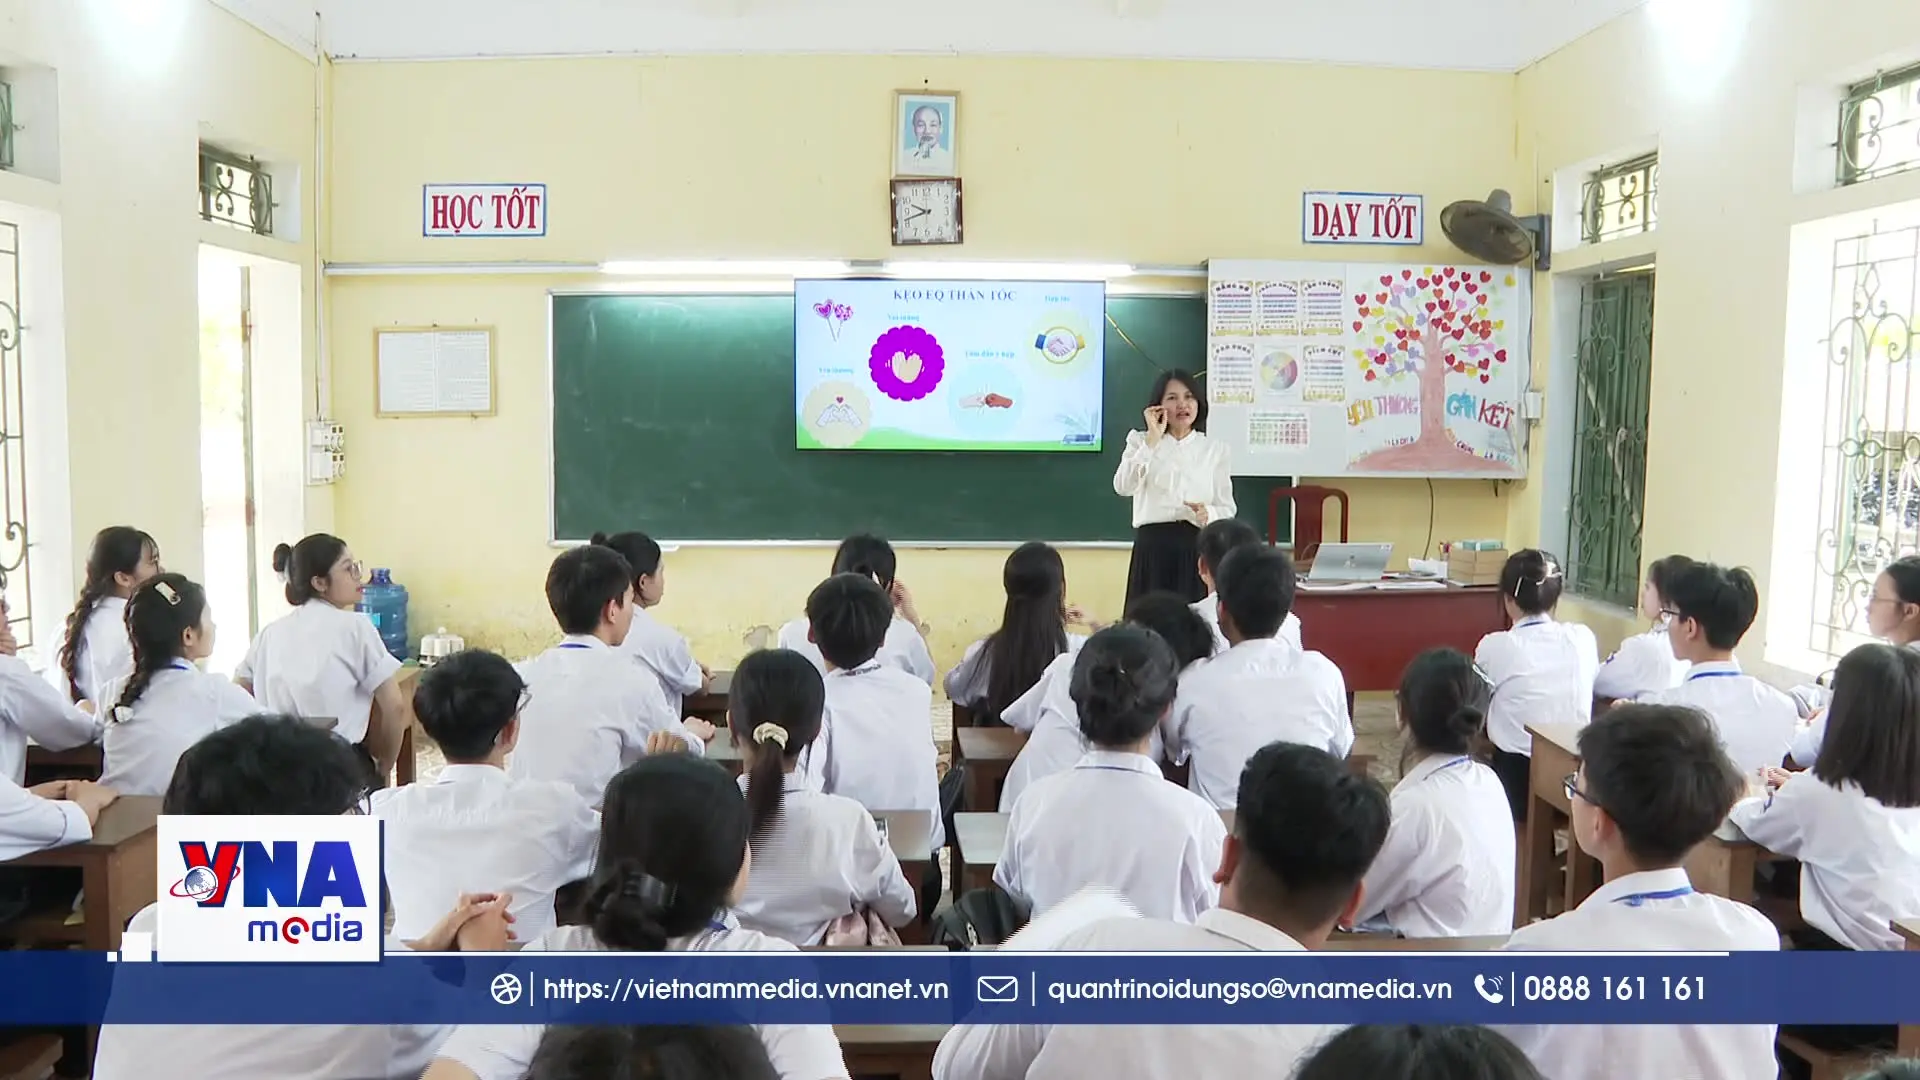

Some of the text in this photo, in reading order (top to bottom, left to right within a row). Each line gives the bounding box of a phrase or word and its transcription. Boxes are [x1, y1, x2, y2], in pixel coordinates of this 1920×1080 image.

[432, 187, 540, 233] HỌC TỐT
[1312, 195, 1417, 240] DẠY TỐT
